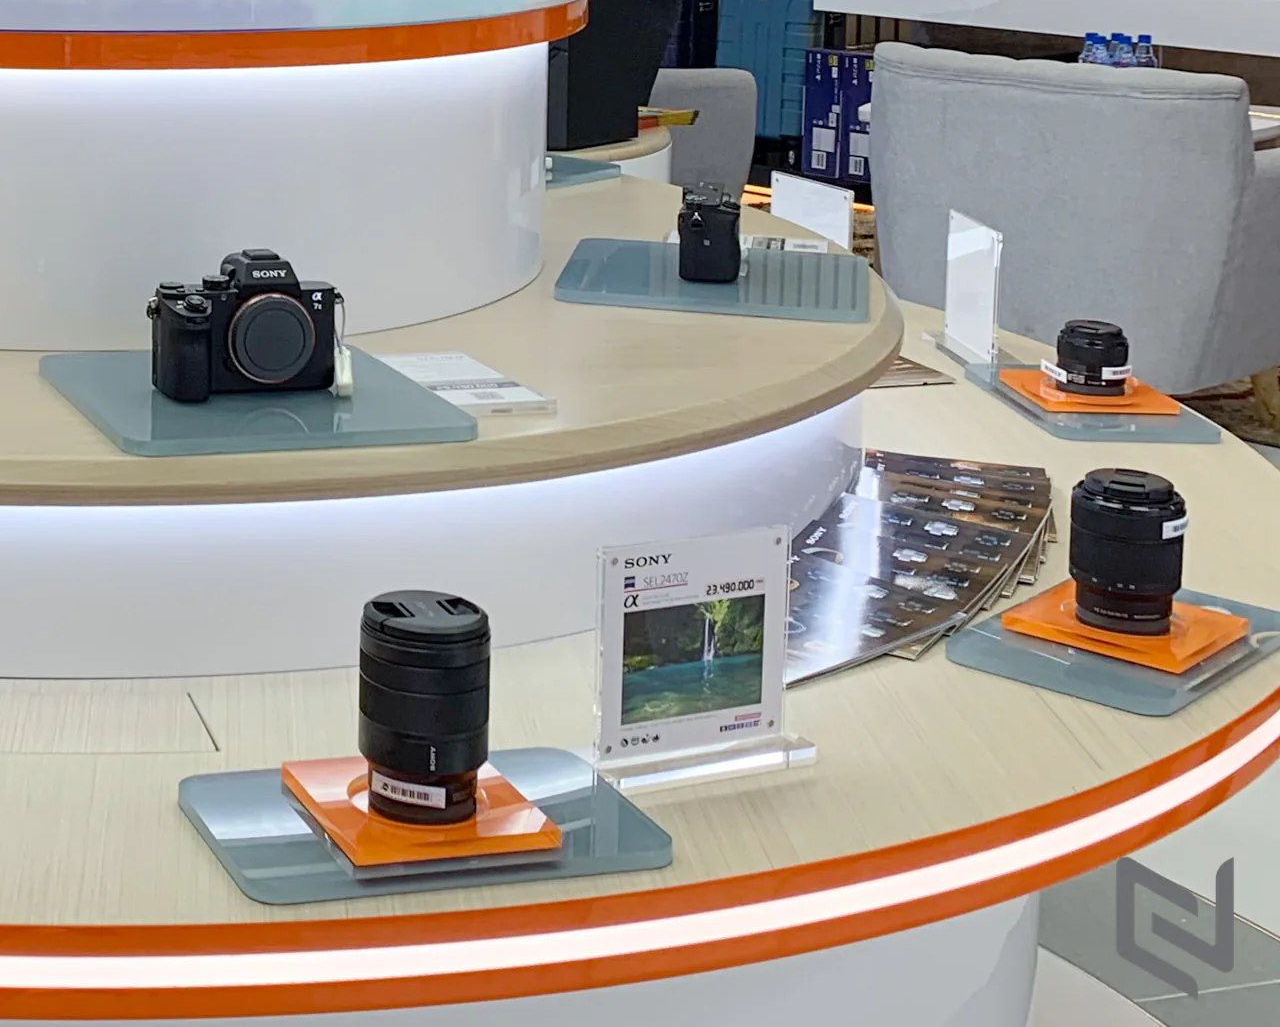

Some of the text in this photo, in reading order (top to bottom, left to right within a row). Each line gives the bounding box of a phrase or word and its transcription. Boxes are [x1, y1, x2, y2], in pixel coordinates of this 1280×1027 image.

[252, 270, 287, 278] SONY
[624, 554, 672, 569] SONY
[643, 572, 689, 588] SEL2470Z
[429, 746, 437, 772] SONY
